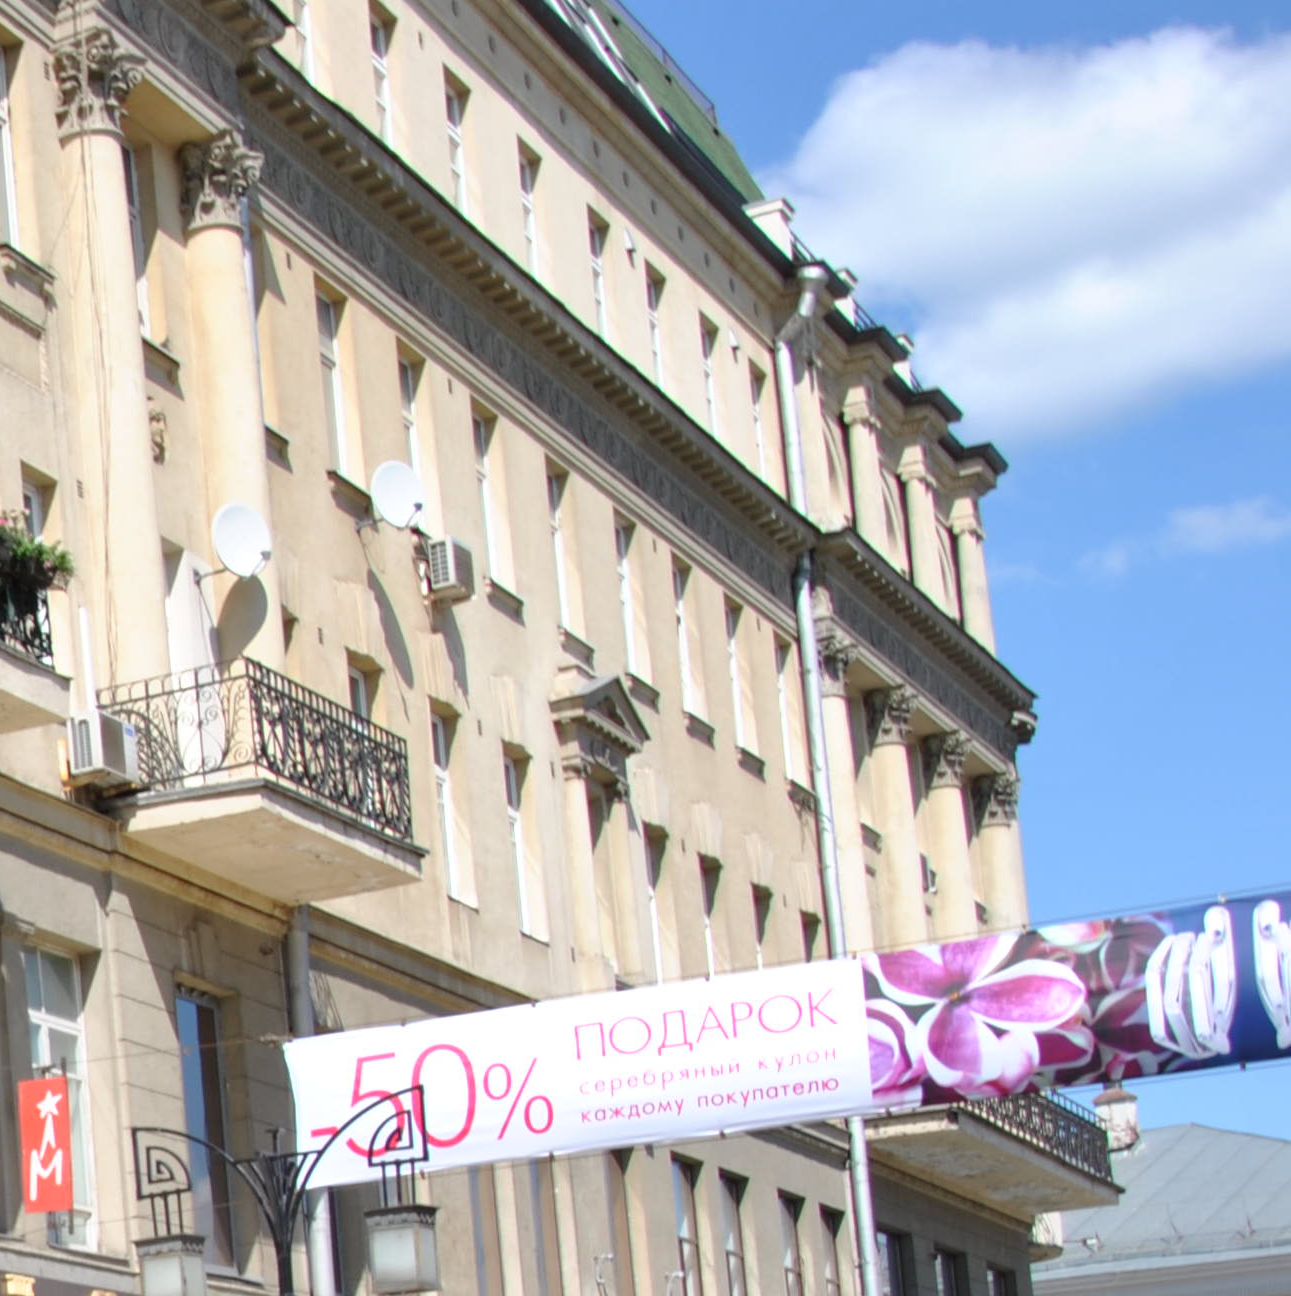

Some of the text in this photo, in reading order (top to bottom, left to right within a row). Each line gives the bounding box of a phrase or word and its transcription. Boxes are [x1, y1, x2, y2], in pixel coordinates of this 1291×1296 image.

[574, 988, 838, 1060] ПОДАРОК
[579, 1047, 837, 1096] серебряный кулон
[581, 1077, 840, 1123] каждому покупателю
